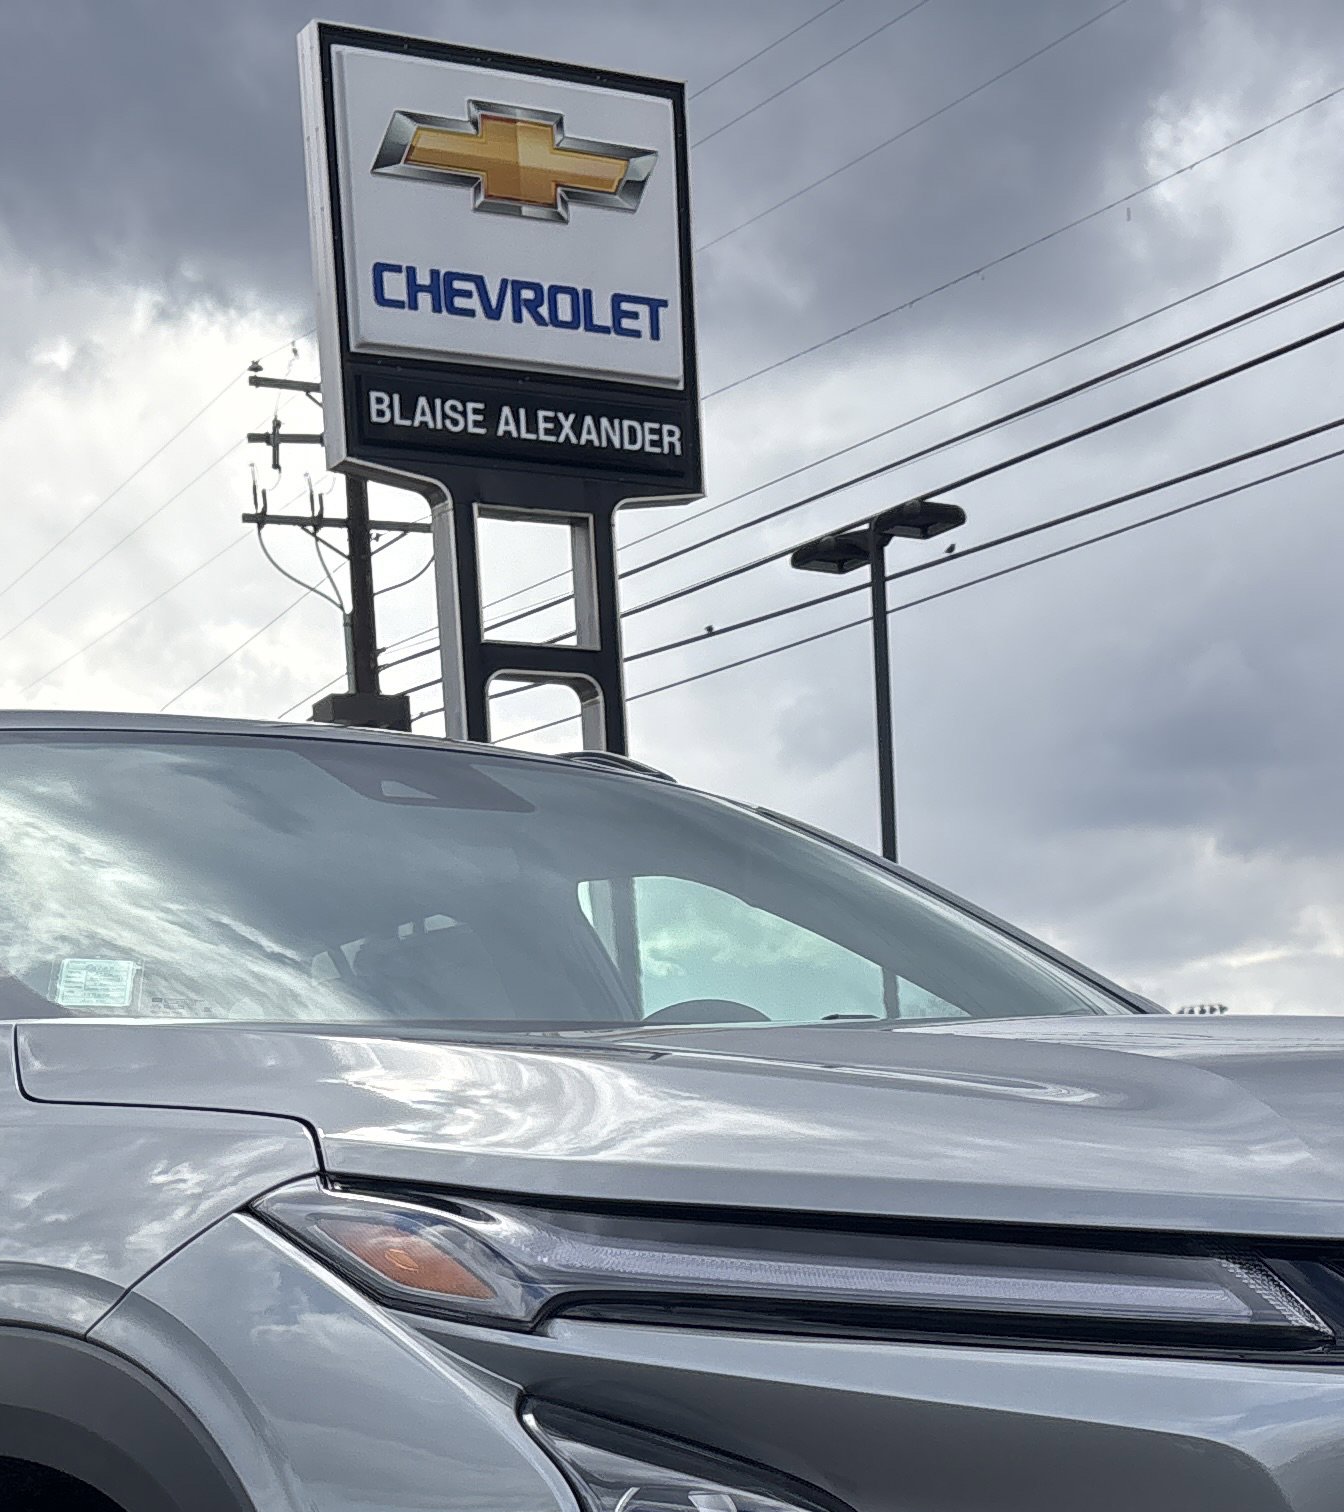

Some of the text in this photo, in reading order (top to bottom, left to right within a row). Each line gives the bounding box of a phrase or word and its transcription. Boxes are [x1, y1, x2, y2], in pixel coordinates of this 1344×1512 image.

[371, 261, 669, 341] CHEVROLET
[368, 390, 683, 456] BLAISE ALEXANDER
